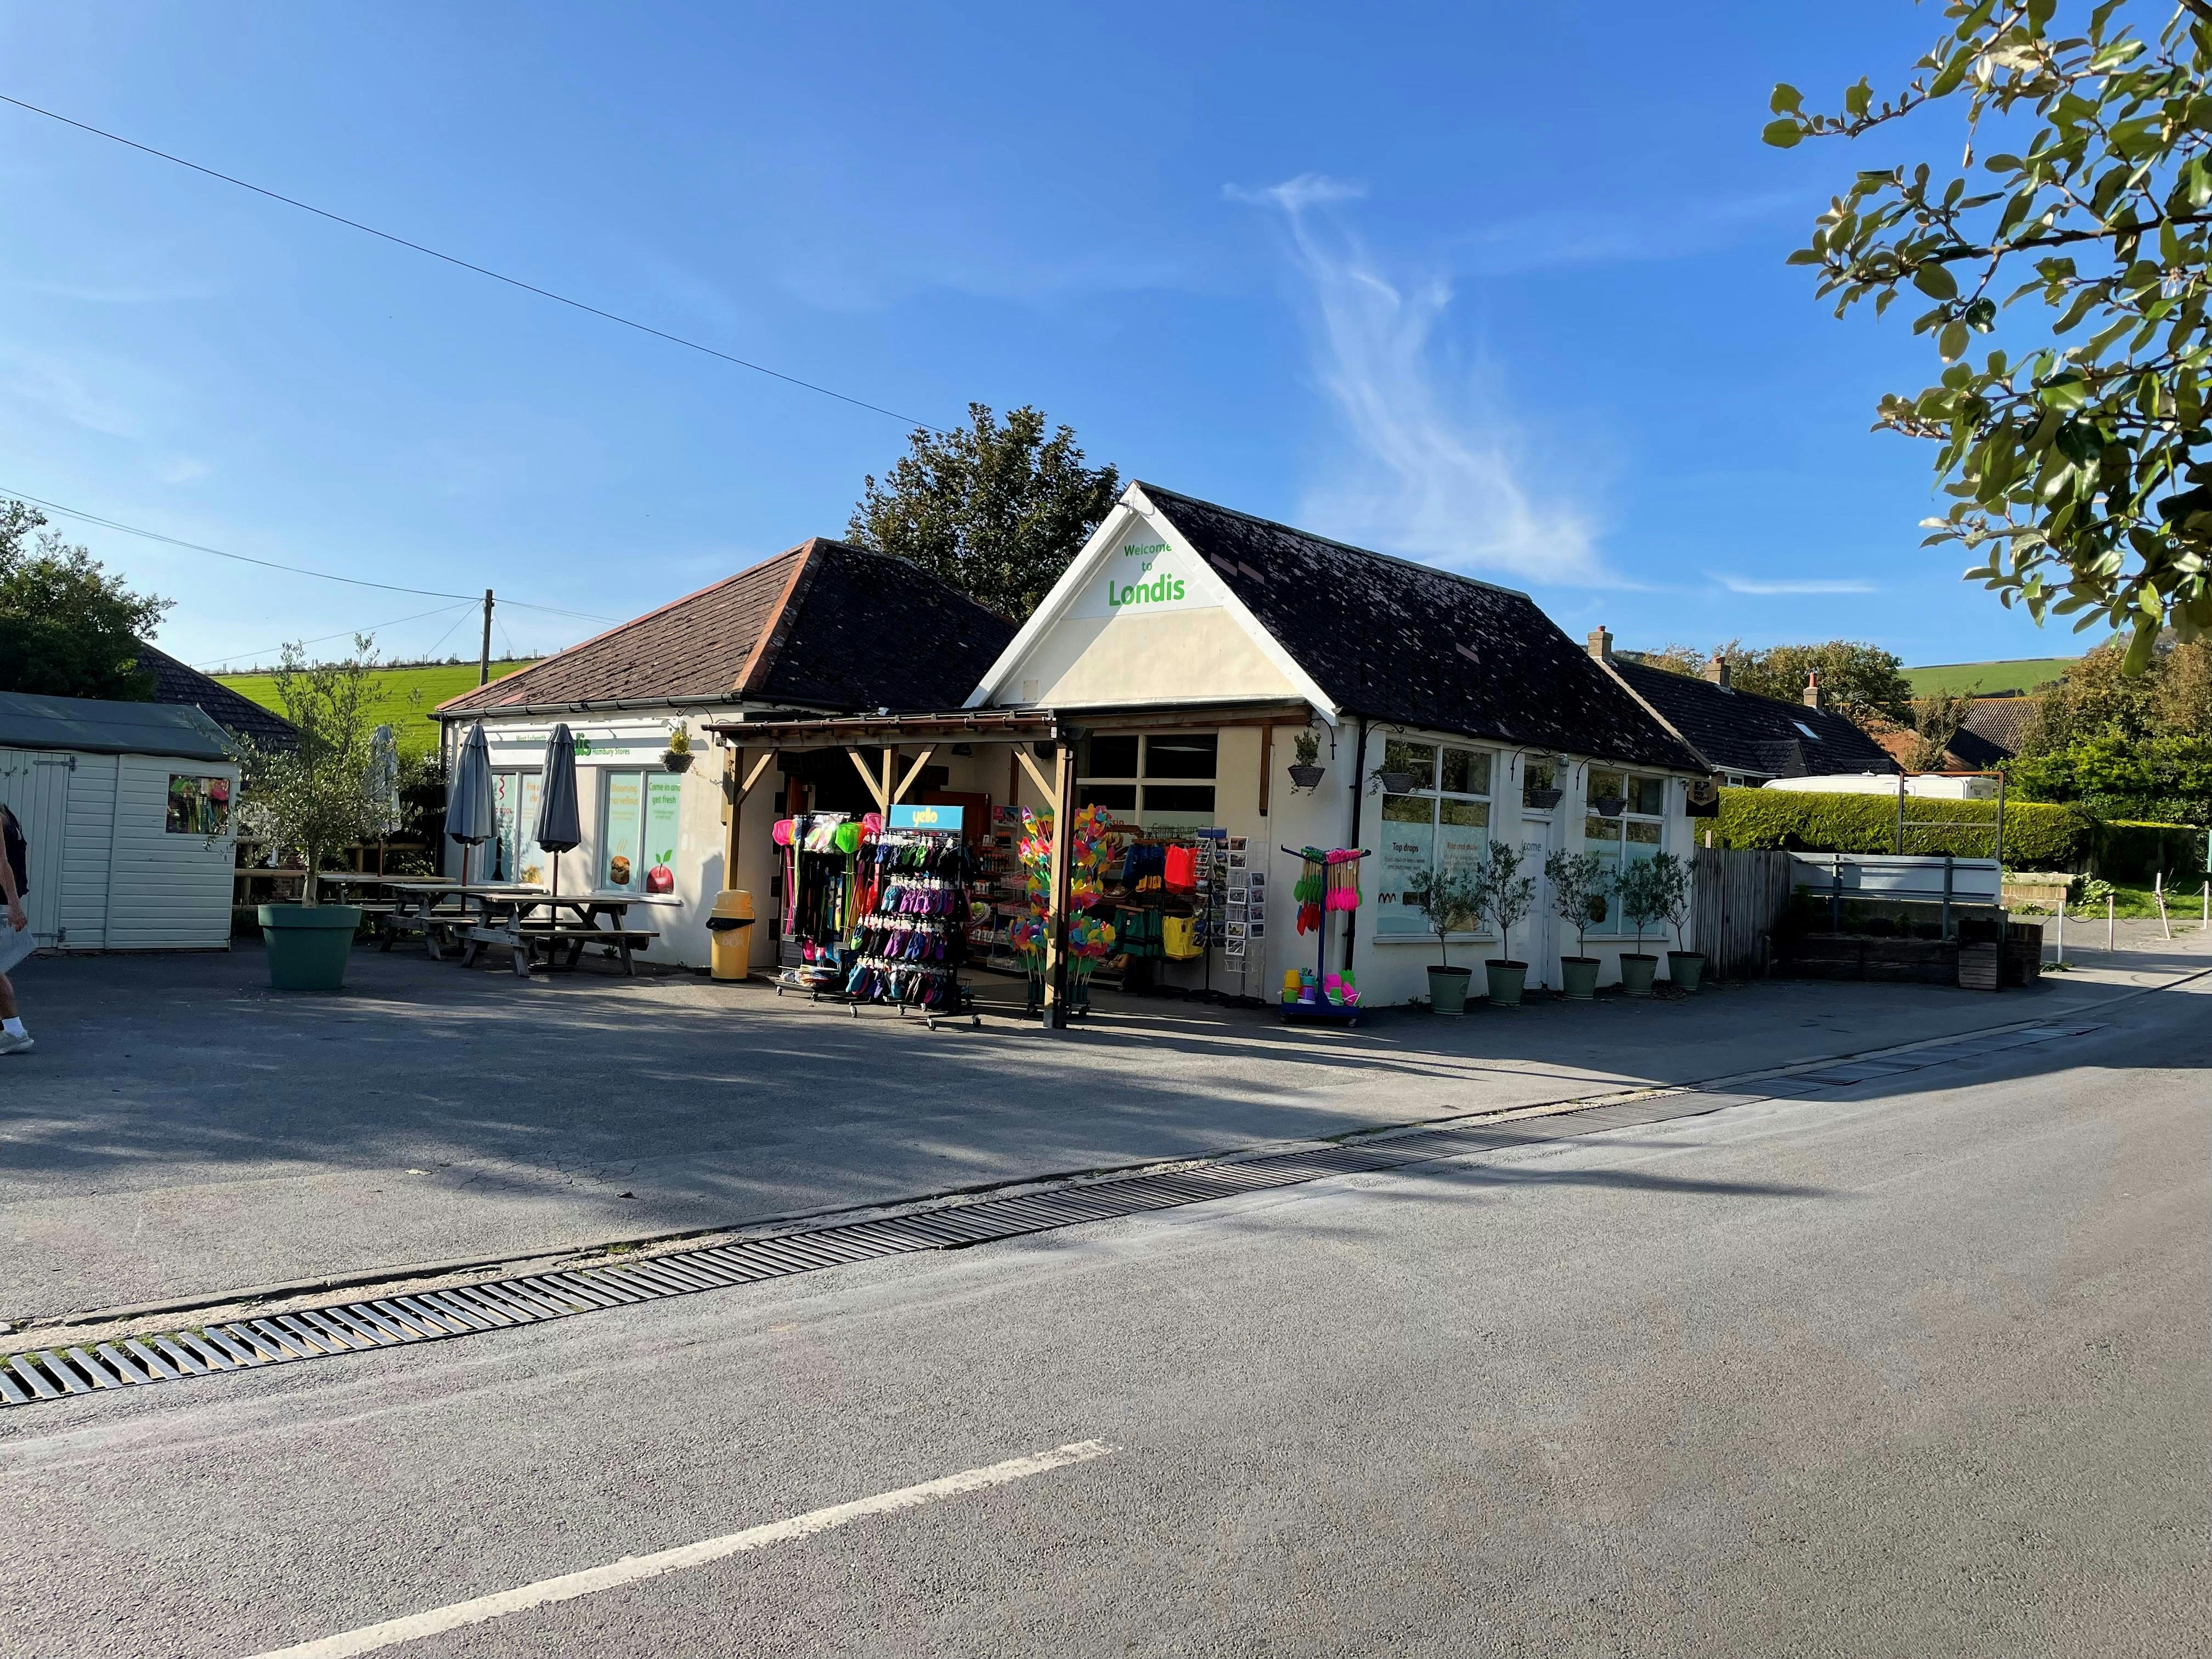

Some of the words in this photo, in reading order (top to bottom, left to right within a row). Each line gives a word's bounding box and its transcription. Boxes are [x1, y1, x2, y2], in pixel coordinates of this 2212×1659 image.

[1124, 543, 1172, 556] Welcome
[1141, 561, 1152, 572] to
[1109, 573, 1185, 606] Londis
[592, 748, 614, 757] Hambury
[611, 784, 637, 794] Blooming
[648, 782, 663, 791] Come
[652, 796, 661, 805] get
[662, 795, 676, 804] fresh
[912, 806, 938, 827] yello
[1392, 842, 1402, 853] Top
[1404, 843, 1419, 854] drops
